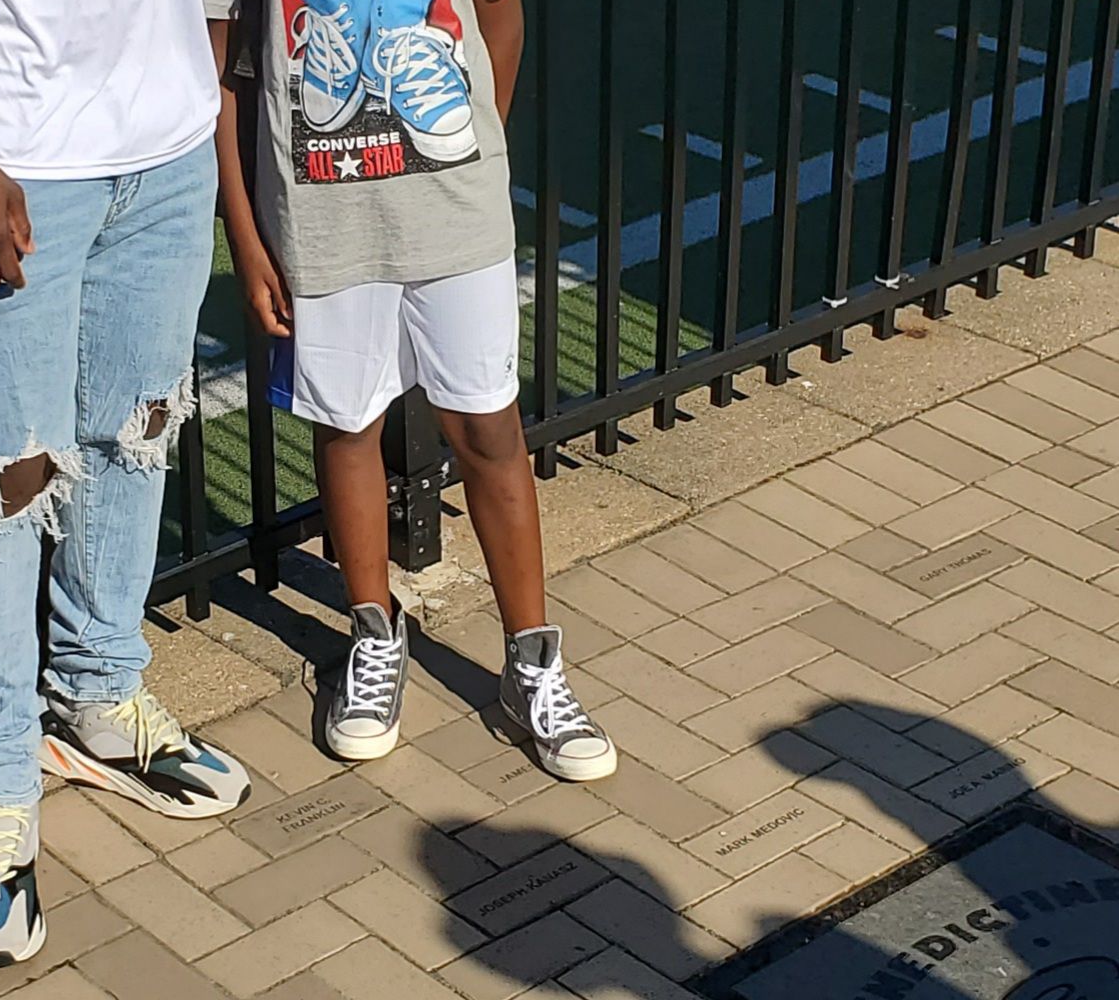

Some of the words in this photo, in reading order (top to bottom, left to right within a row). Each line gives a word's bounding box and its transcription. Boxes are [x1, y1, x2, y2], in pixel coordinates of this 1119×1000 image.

[307, 131, 401, 153] CONVERSE
[308, 151, 337, 181] ALL
[363, 144, 405, 177] STAR
[946, 547, 993, 570] THOMAS
[275, 802, 317, 825] KEVIN
[281, 801, 347, 834] FRANKLIN
[714, 835, 753, 857] MARK
[749, 806, 806, 839] MEDOVIC
[479, 887, 529, 918] JOSEPH
